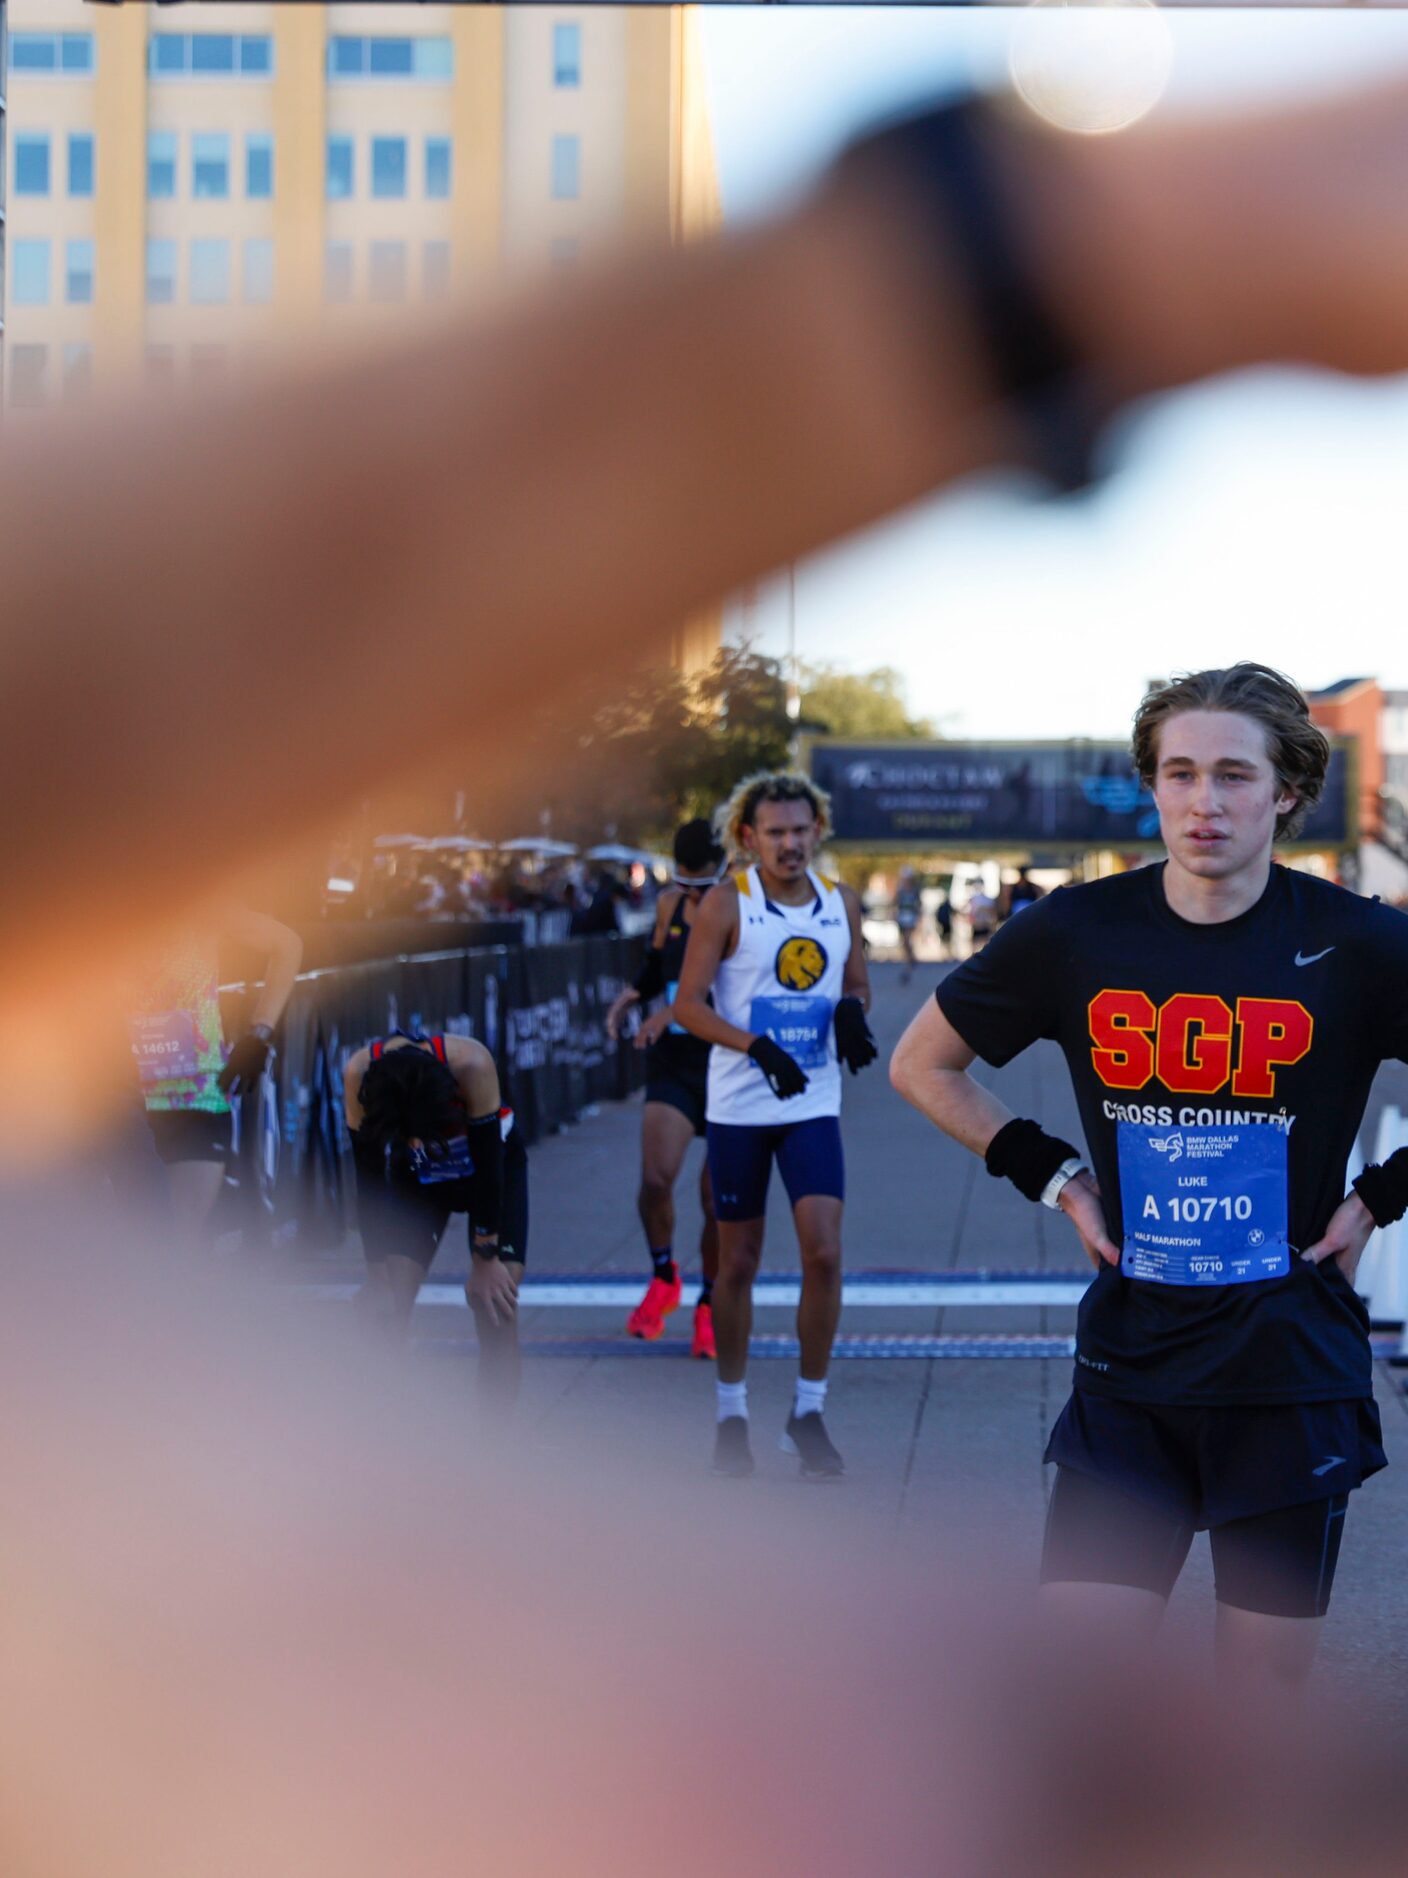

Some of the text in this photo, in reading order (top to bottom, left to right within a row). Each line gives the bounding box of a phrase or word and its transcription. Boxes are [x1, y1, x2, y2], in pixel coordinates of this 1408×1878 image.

[143, 1040, 180, 1055] 14612
[1088, 989, 1313, 1098] SGP
[1103, 1100, 1173, 1126] CROSS
[1186, 1135, 1239, 1144] BMW DALLAS
[1186, 1142, 1232, 1150] MARATHON
[1186, 1149, 1224, 1158] FESTIVAL
[1178, 1176, 1208, 1187] LUKE
[1143, 1194, 1253, 1223] A 10710
[1134, 1232, 1202, 1247] HALF MARATHON
[1189, 1261, 1223, 1273] 10710
